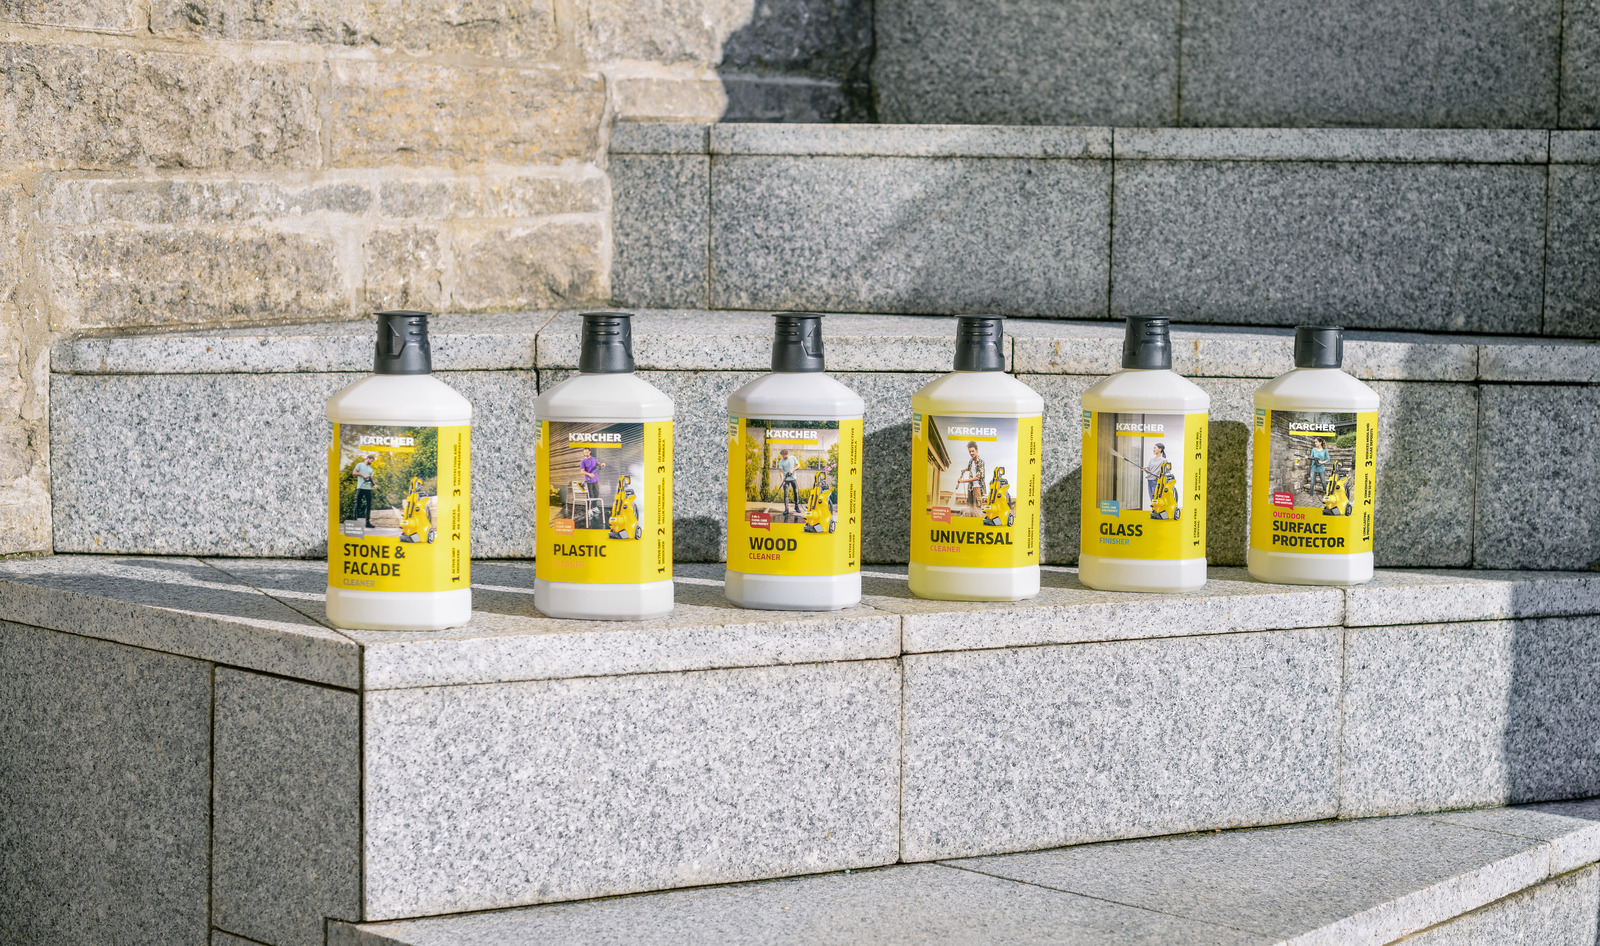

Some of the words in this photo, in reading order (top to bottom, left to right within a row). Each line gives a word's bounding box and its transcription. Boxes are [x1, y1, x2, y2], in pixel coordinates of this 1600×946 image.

[948, 426, 998, 436] KÄRCHER
[1116, 423, 1164, 432] KÄRCHER
[568, 432, 622, 442] KÄRCHER
[766, 430, 818, 439] KÄRCHER
[452, 489, 461, 497] 3
[1272, 511, 1306, 520] OUTDOOR
[1100, 522, 1142, 536] GLASS
[1272, 520, 1327, 534] SURFACE
[452, 532, 461, 541] 2
[930, 530, 1013, 546] UNIVERSAL
[1272, 534, 1344, 548] PROTECTOR
[750, 536, 798, 551] WOOD
[930, 544, 961, 553] CLEANER
[344, 543, 390, 559] STONE
[394, 546, 406, 559] &
[554, 544, 606, 558] PLASTIC
[748, 552, 781, 561] CLEANER
[344, 561, 400, 576] FACADE
[553, 560, 584, 568] CLEANER
[343, 578, 376, 588] CLEANER
